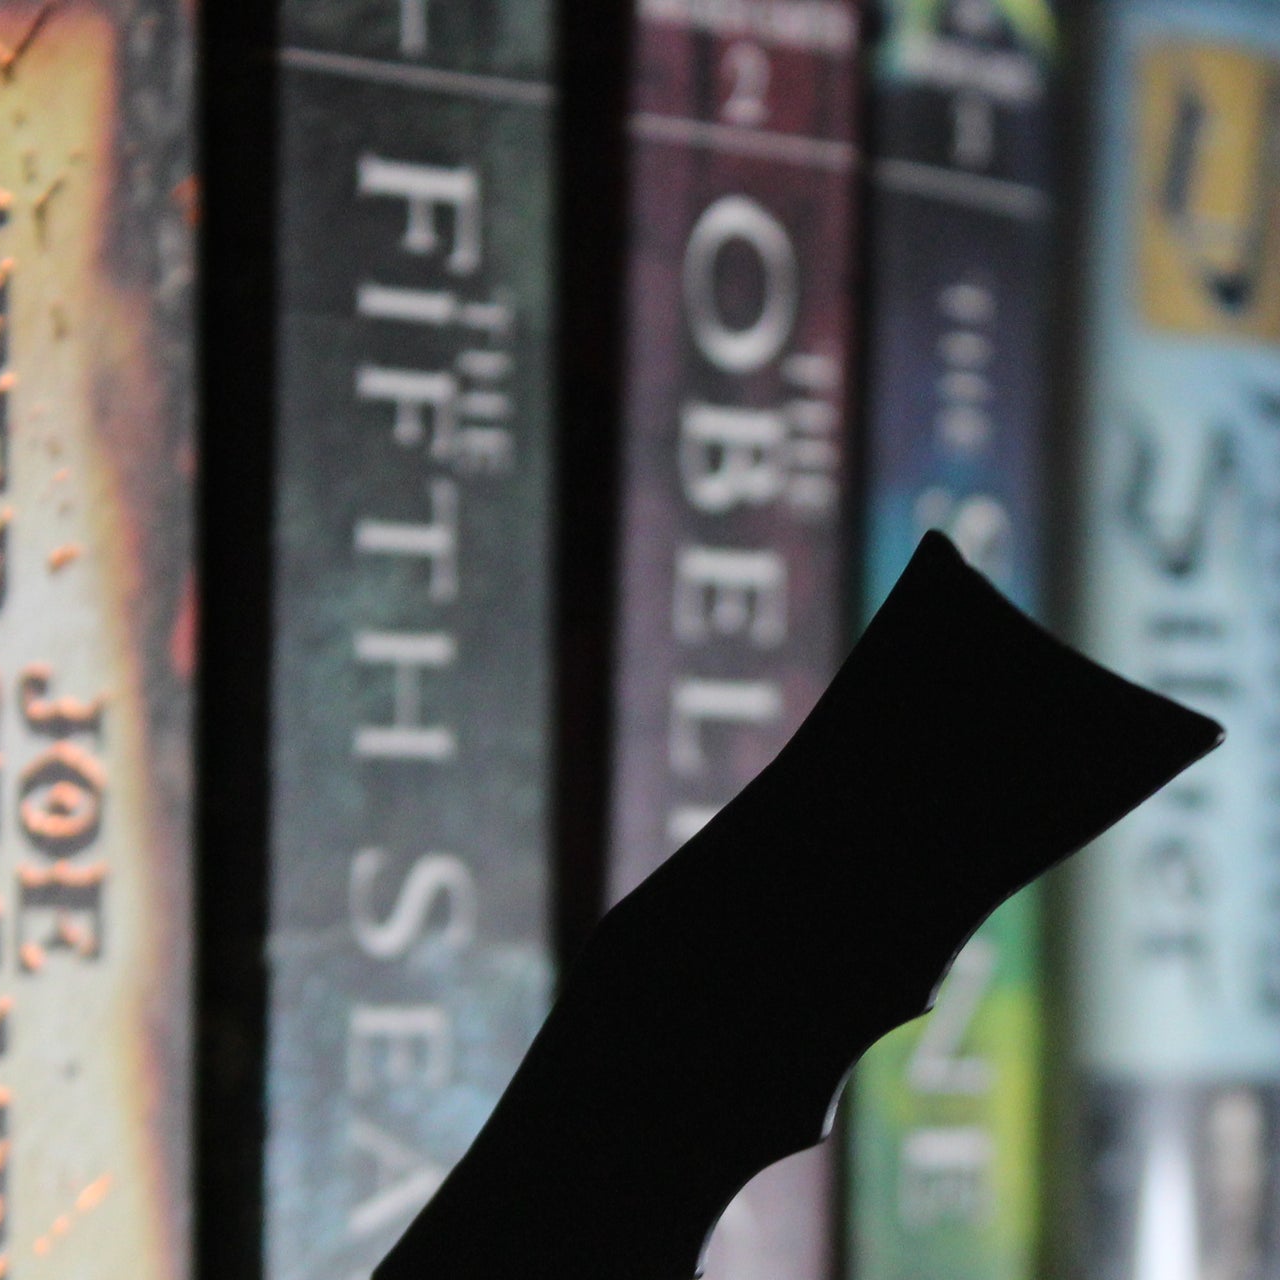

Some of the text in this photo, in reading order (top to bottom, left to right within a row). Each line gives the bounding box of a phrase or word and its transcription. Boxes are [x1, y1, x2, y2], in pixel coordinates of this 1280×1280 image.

[354, 154, 483, 763] FIFTH
[456, 303, 517, 474] THE
[667, 195, 800, 842] OBEL
[14, 664, 107, 977] JOE
[346, 846, 480, 1268] SEA
